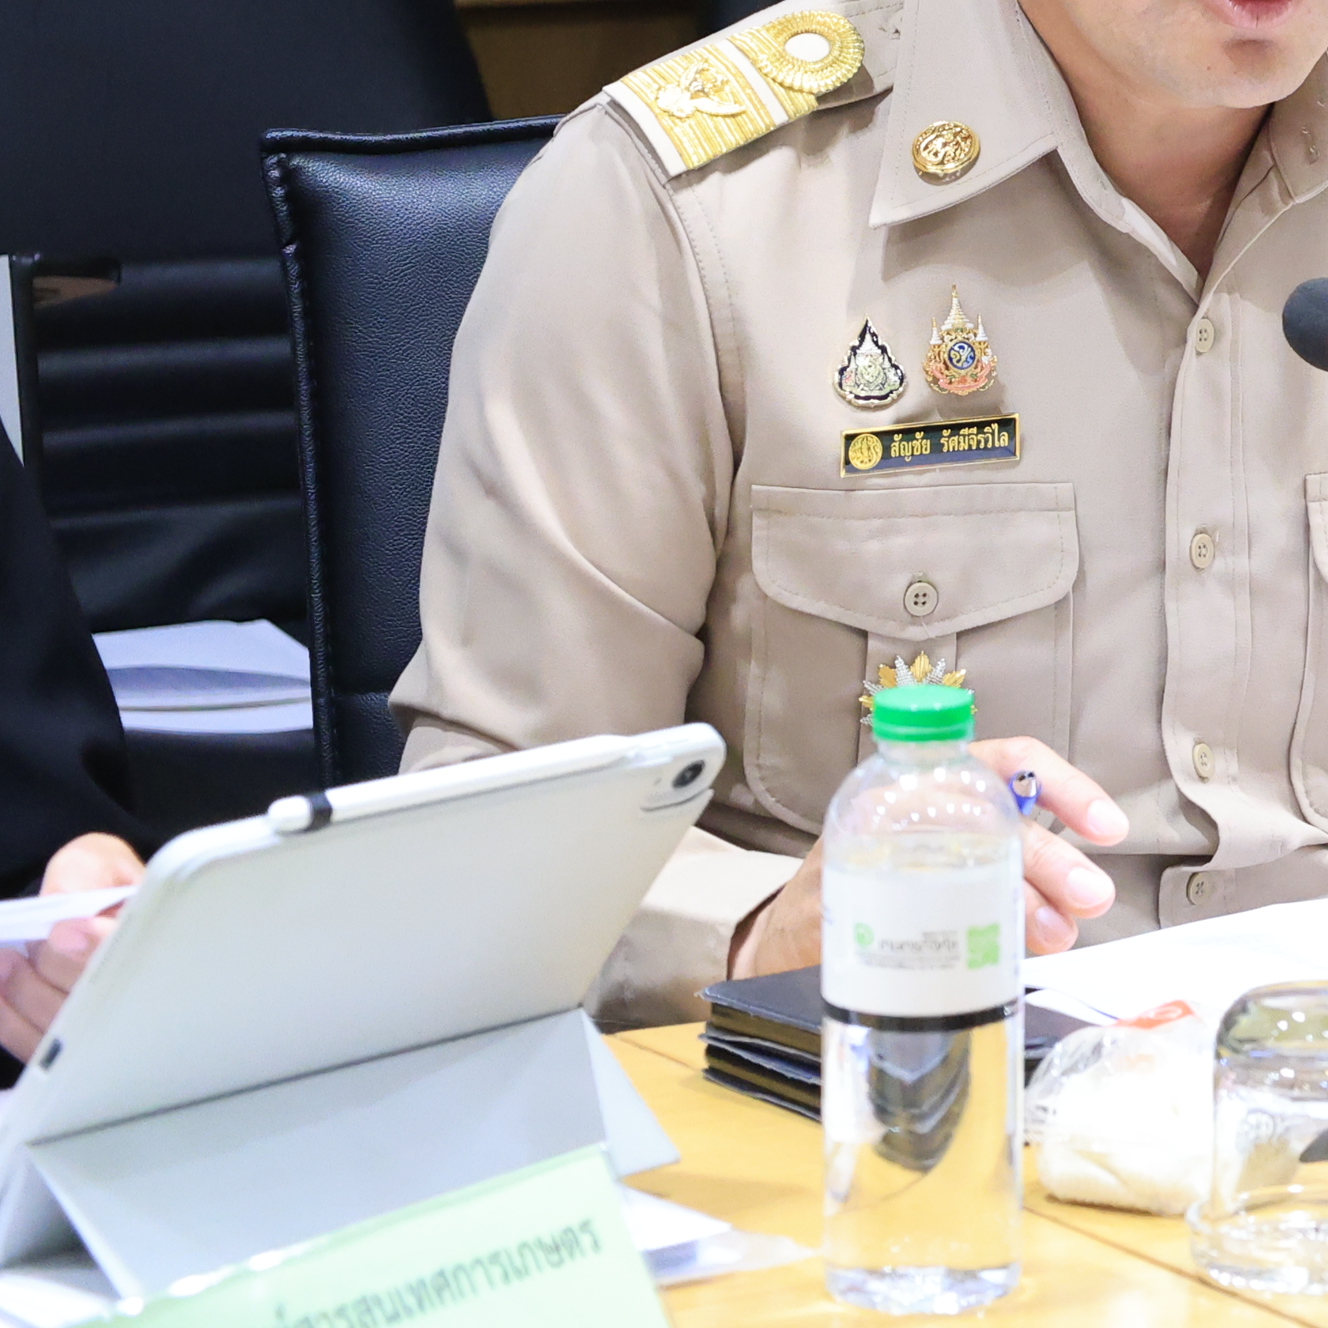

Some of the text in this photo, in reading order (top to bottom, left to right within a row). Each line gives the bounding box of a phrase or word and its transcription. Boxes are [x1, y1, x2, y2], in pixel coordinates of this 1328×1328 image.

[890, 423, 1009, 462] สัญชัย รัศมีจีรวิไล
